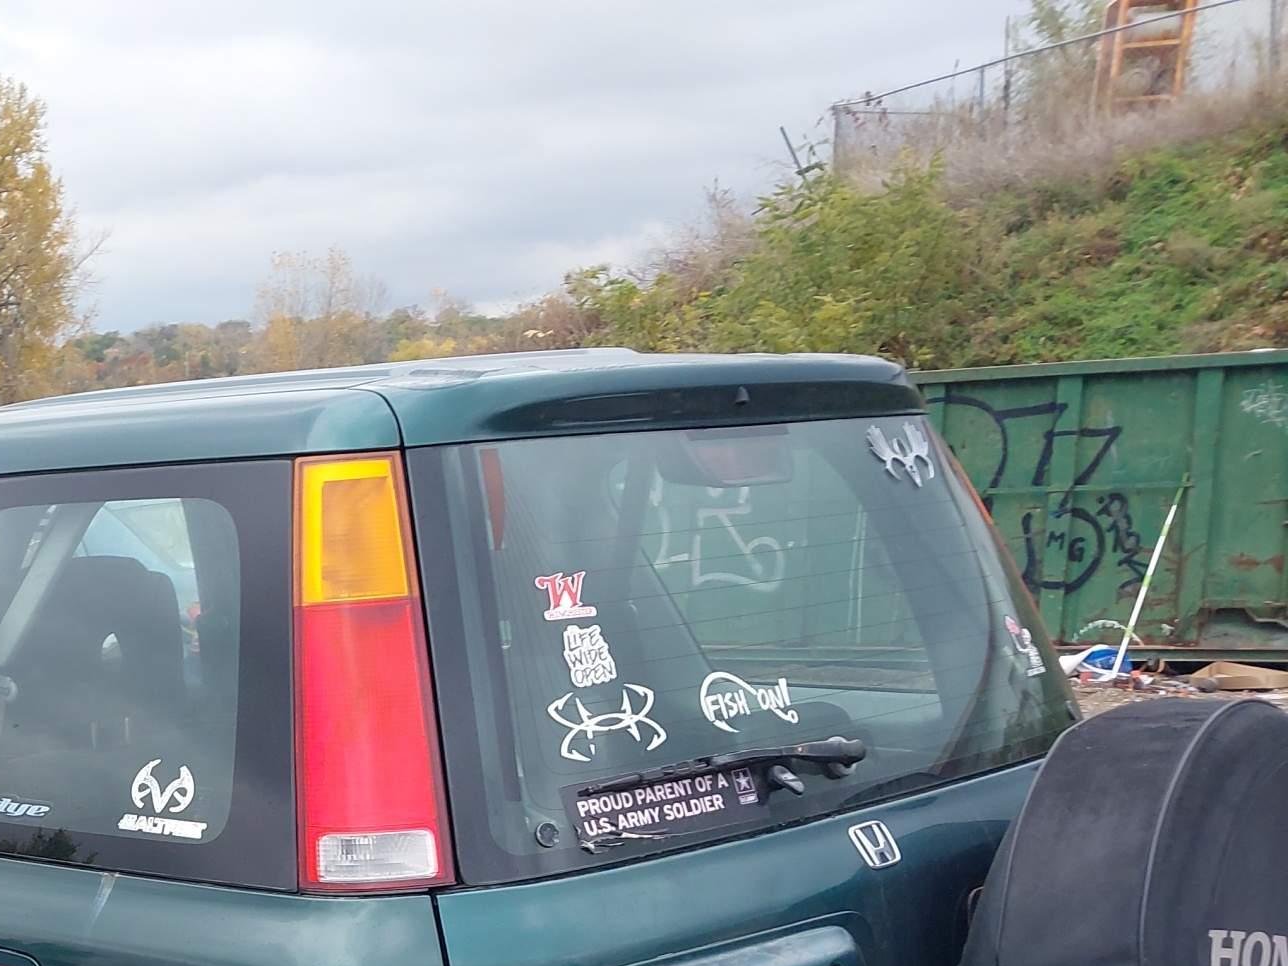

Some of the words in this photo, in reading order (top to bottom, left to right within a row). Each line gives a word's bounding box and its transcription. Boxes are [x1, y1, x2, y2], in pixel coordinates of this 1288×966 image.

[567, 628, 600, 651] LIFE
[567, 646, 608, 668] WIDE
[574, 663, 614, 684] OPEN
[705, 689, 751, 722] FISH
[757, 678, 792, 711] ON!
[576, 791, 634, 818] PROUD
[635, 778, 694, 806] PARENT
[695, 775, 714, 793] OF
[717, 772, 728, 789] A
[583, 818, 616, 838] U.S.
[618, 808, 661, 831] ARMY
[663, 793, 726, 821] SOLDIER
